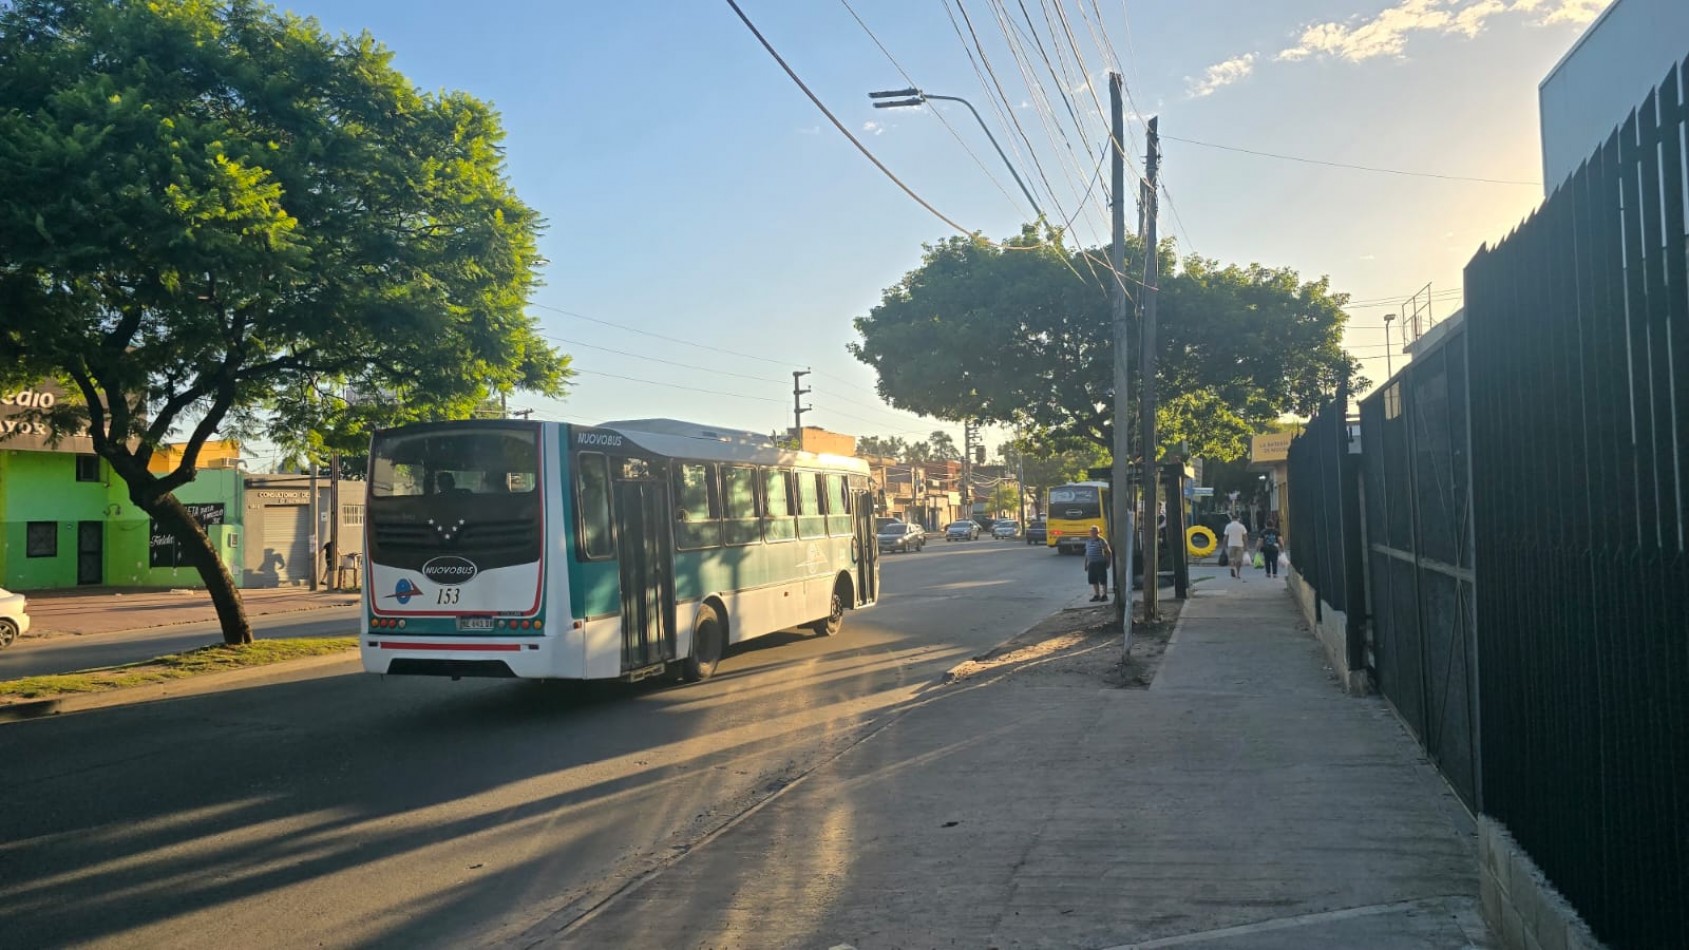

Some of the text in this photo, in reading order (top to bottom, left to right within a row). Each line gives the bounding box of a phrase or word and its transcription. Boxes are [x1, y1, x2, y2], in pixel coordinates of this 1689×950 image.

[578, 432, 622, 446] NUOVOBUS
[425, 566, 474, 575] NUOVOBUS
[437, 588, 460, 605] 153
